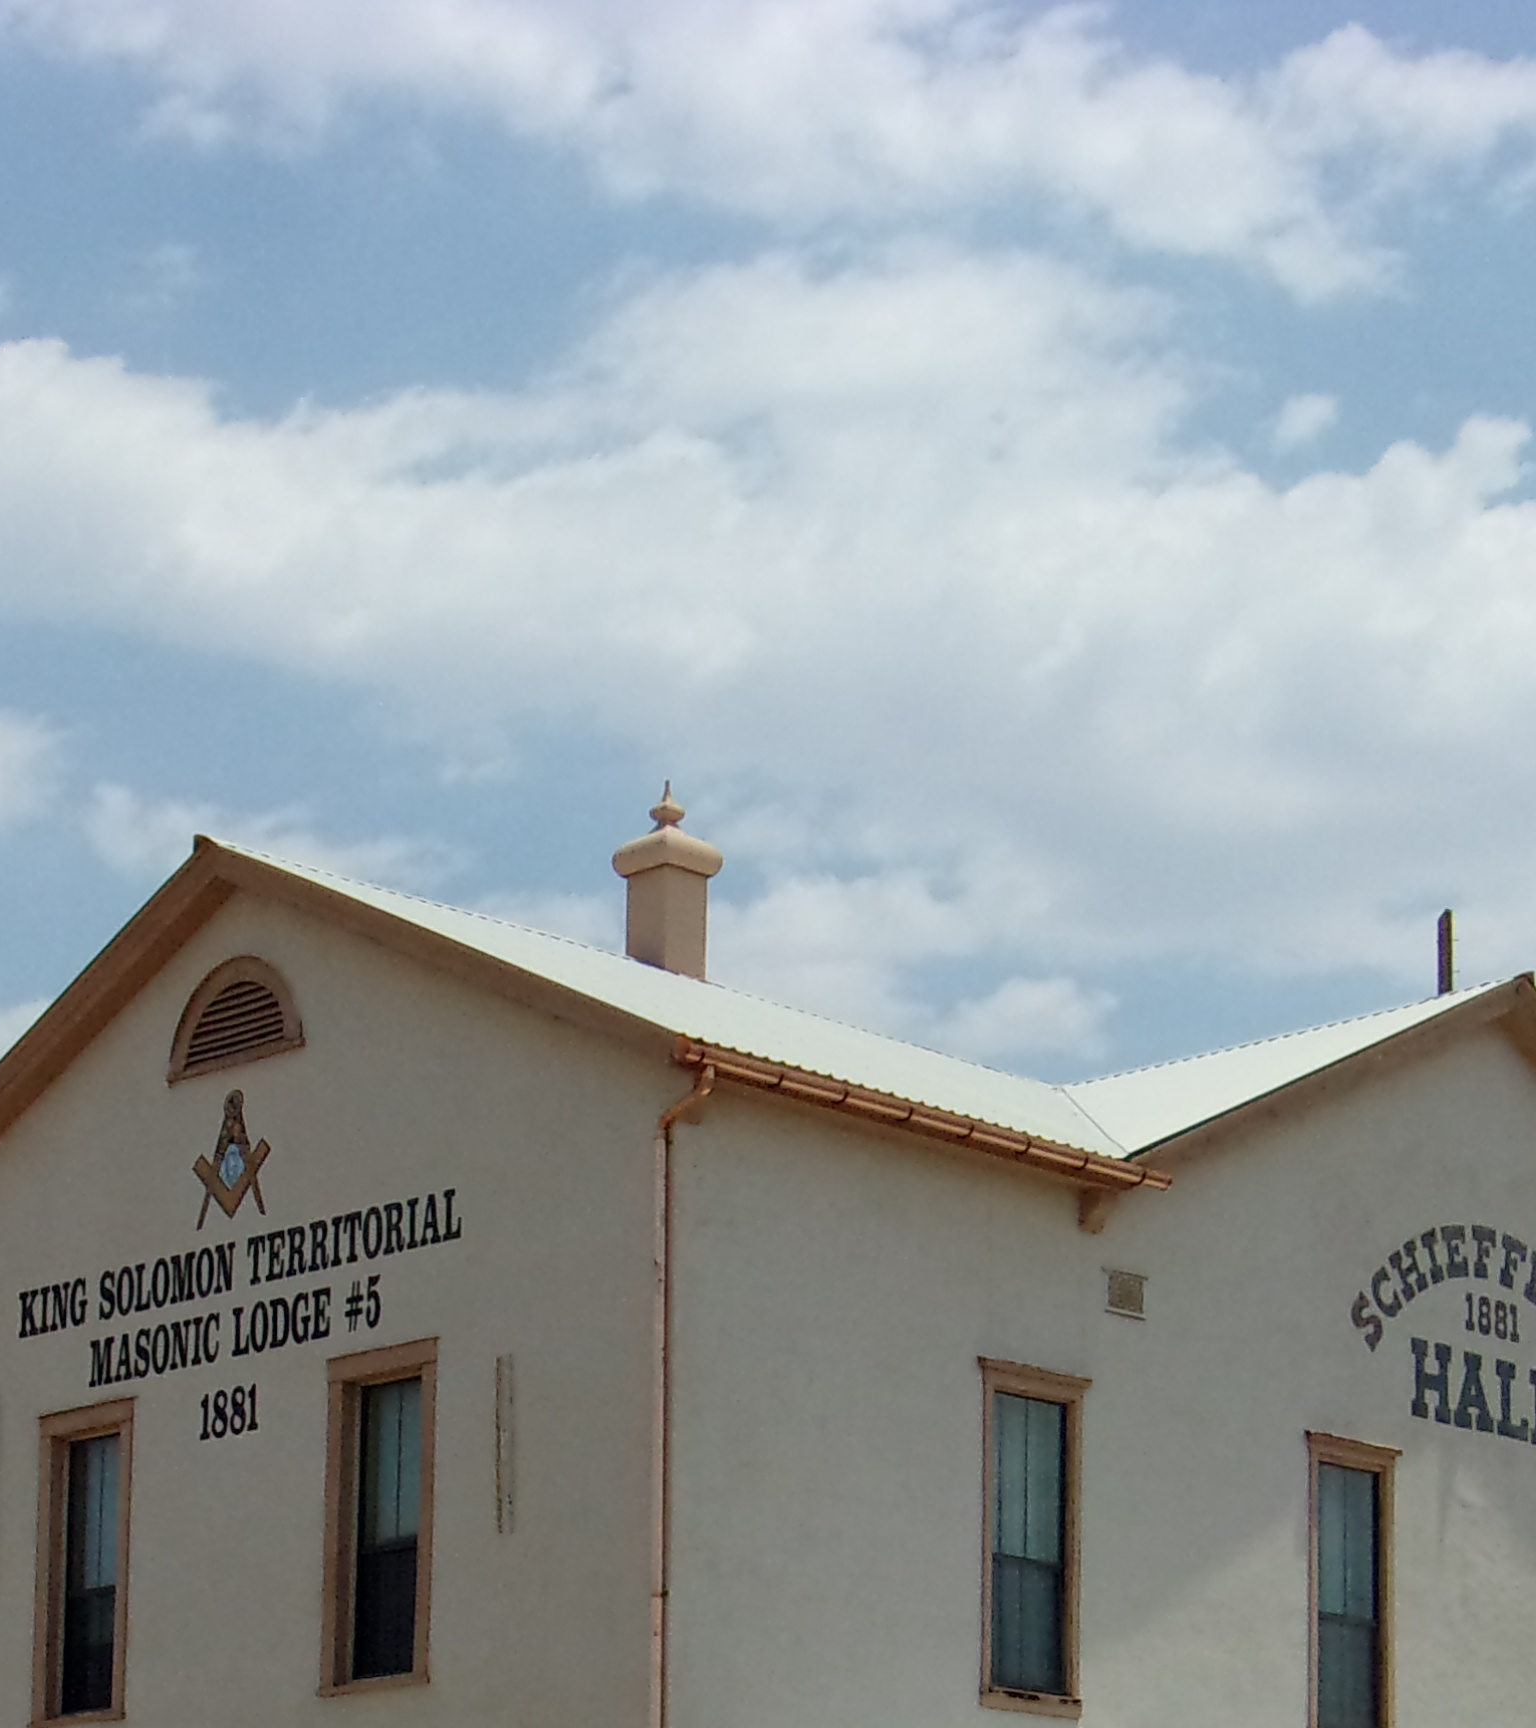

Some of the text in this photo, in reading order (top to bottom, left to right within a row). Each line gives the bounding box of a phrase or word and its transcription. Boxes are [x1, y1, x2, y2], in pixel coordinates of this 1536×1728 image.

[18, 1188, 462, 1339] KING SOLOMON TERRITORIAL
[88, 1273, 382, 1388] MASONIC LODGE #5
[1465, 1292, 1520, 1344] 1881
[199, 1382, 259, 1442] 1881
